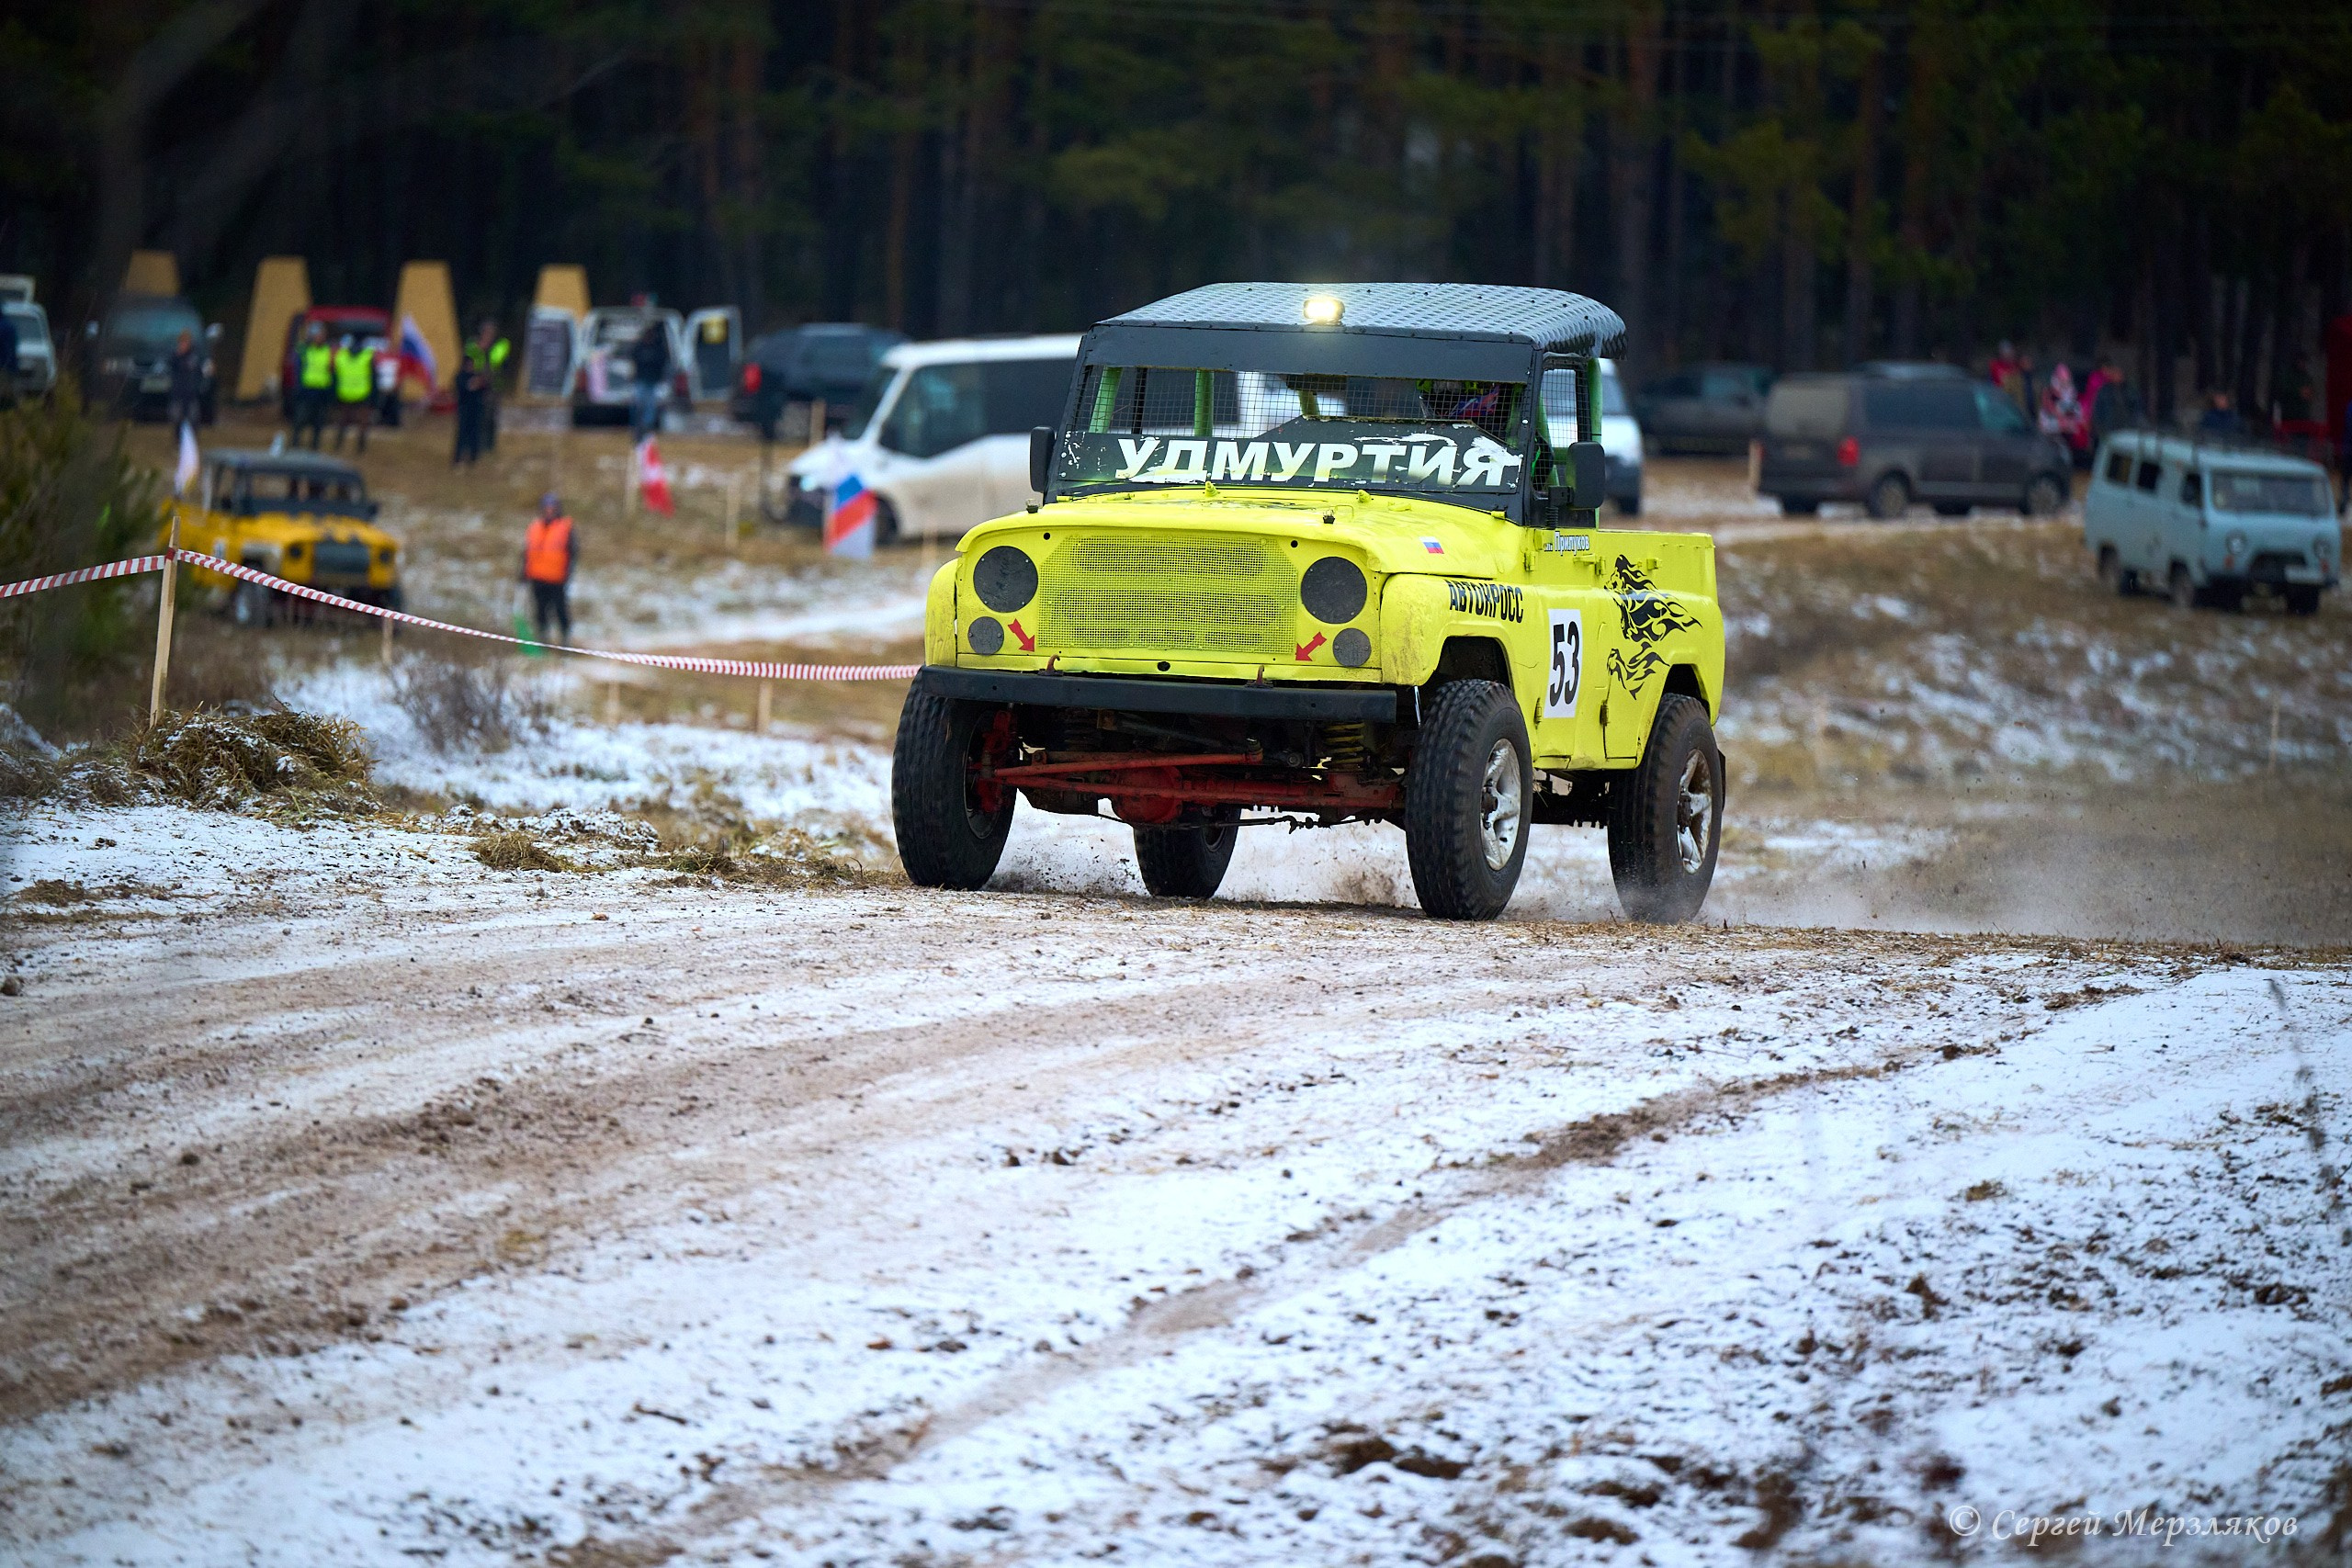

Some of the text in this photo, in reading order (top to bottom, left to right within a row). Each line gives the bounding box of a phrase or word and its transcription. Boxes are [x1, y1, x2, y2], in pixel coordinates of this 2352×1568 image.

[1115, 438, 1511, 488] УДМУРТИЯ
[1555, 530, 1590, 556] Прилуков
[1444, 579, 1524, 624] АВТОКРОСС
[1549, 621, 1580, 707] 53
